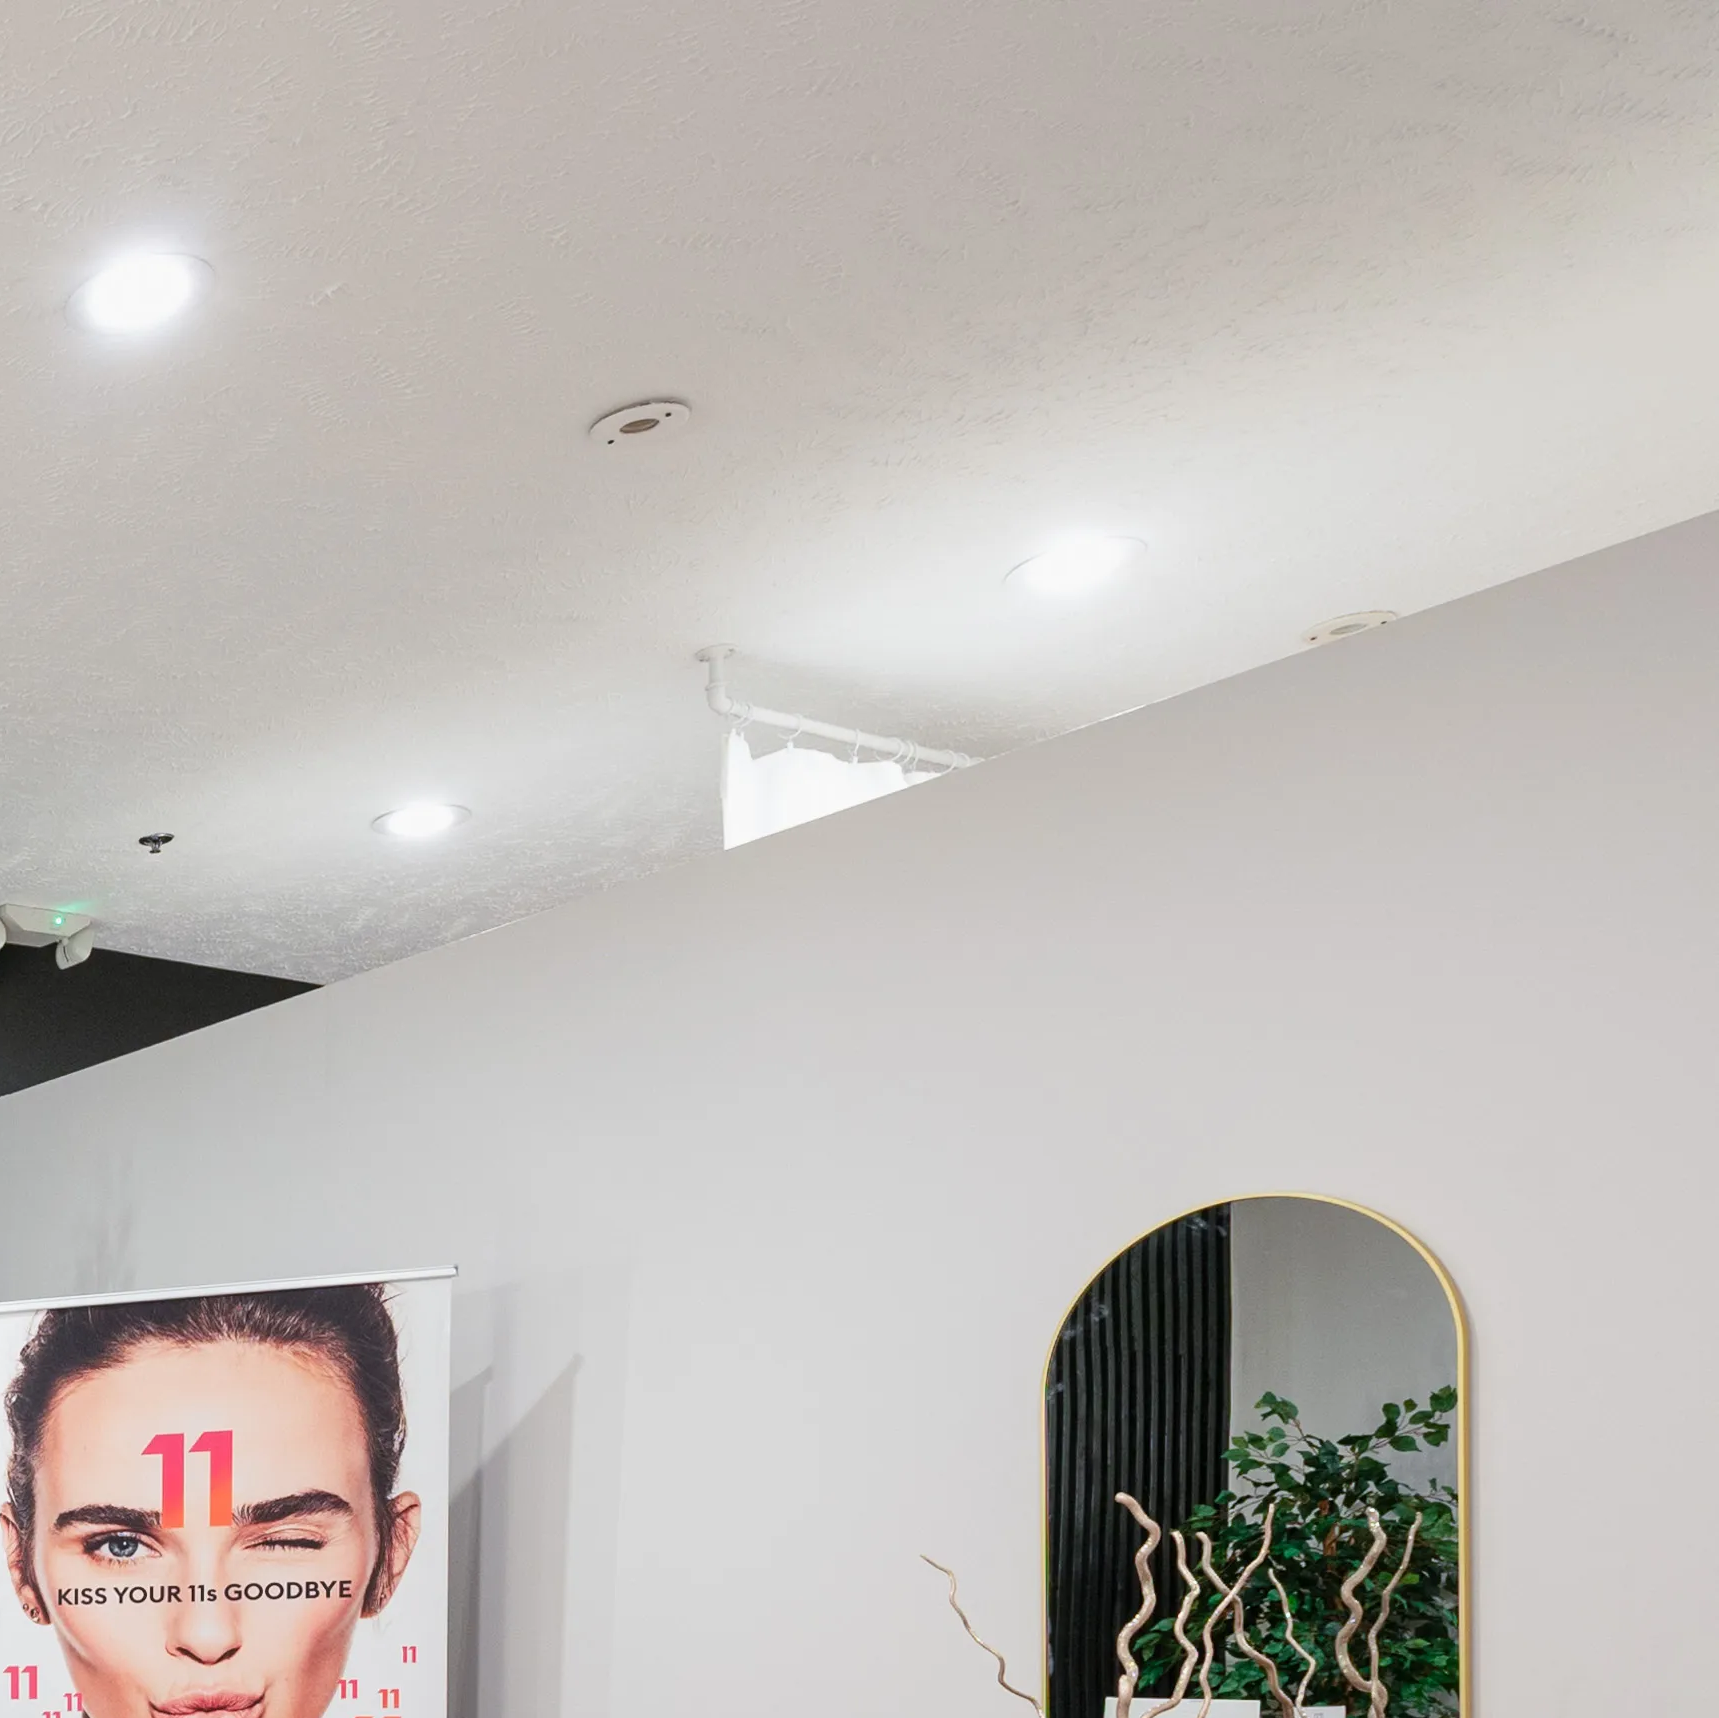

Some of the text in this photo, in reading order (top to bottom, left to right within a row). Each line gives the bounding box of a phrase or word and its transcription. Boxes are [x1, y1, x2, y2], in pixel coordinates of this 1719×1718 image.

[141, 1429, 233, 1528] 11
[57, 1580, 352, 1606] KISS YOUR 11s GOODBYE
[401, 1646, 417, 1664] 11
[3, 1665, 38, 1699] 11
[337, 1679, 358, 1699] 11
[63, 1693, 83, 1711] 11
[377, 1688, 400, 1708] 11
